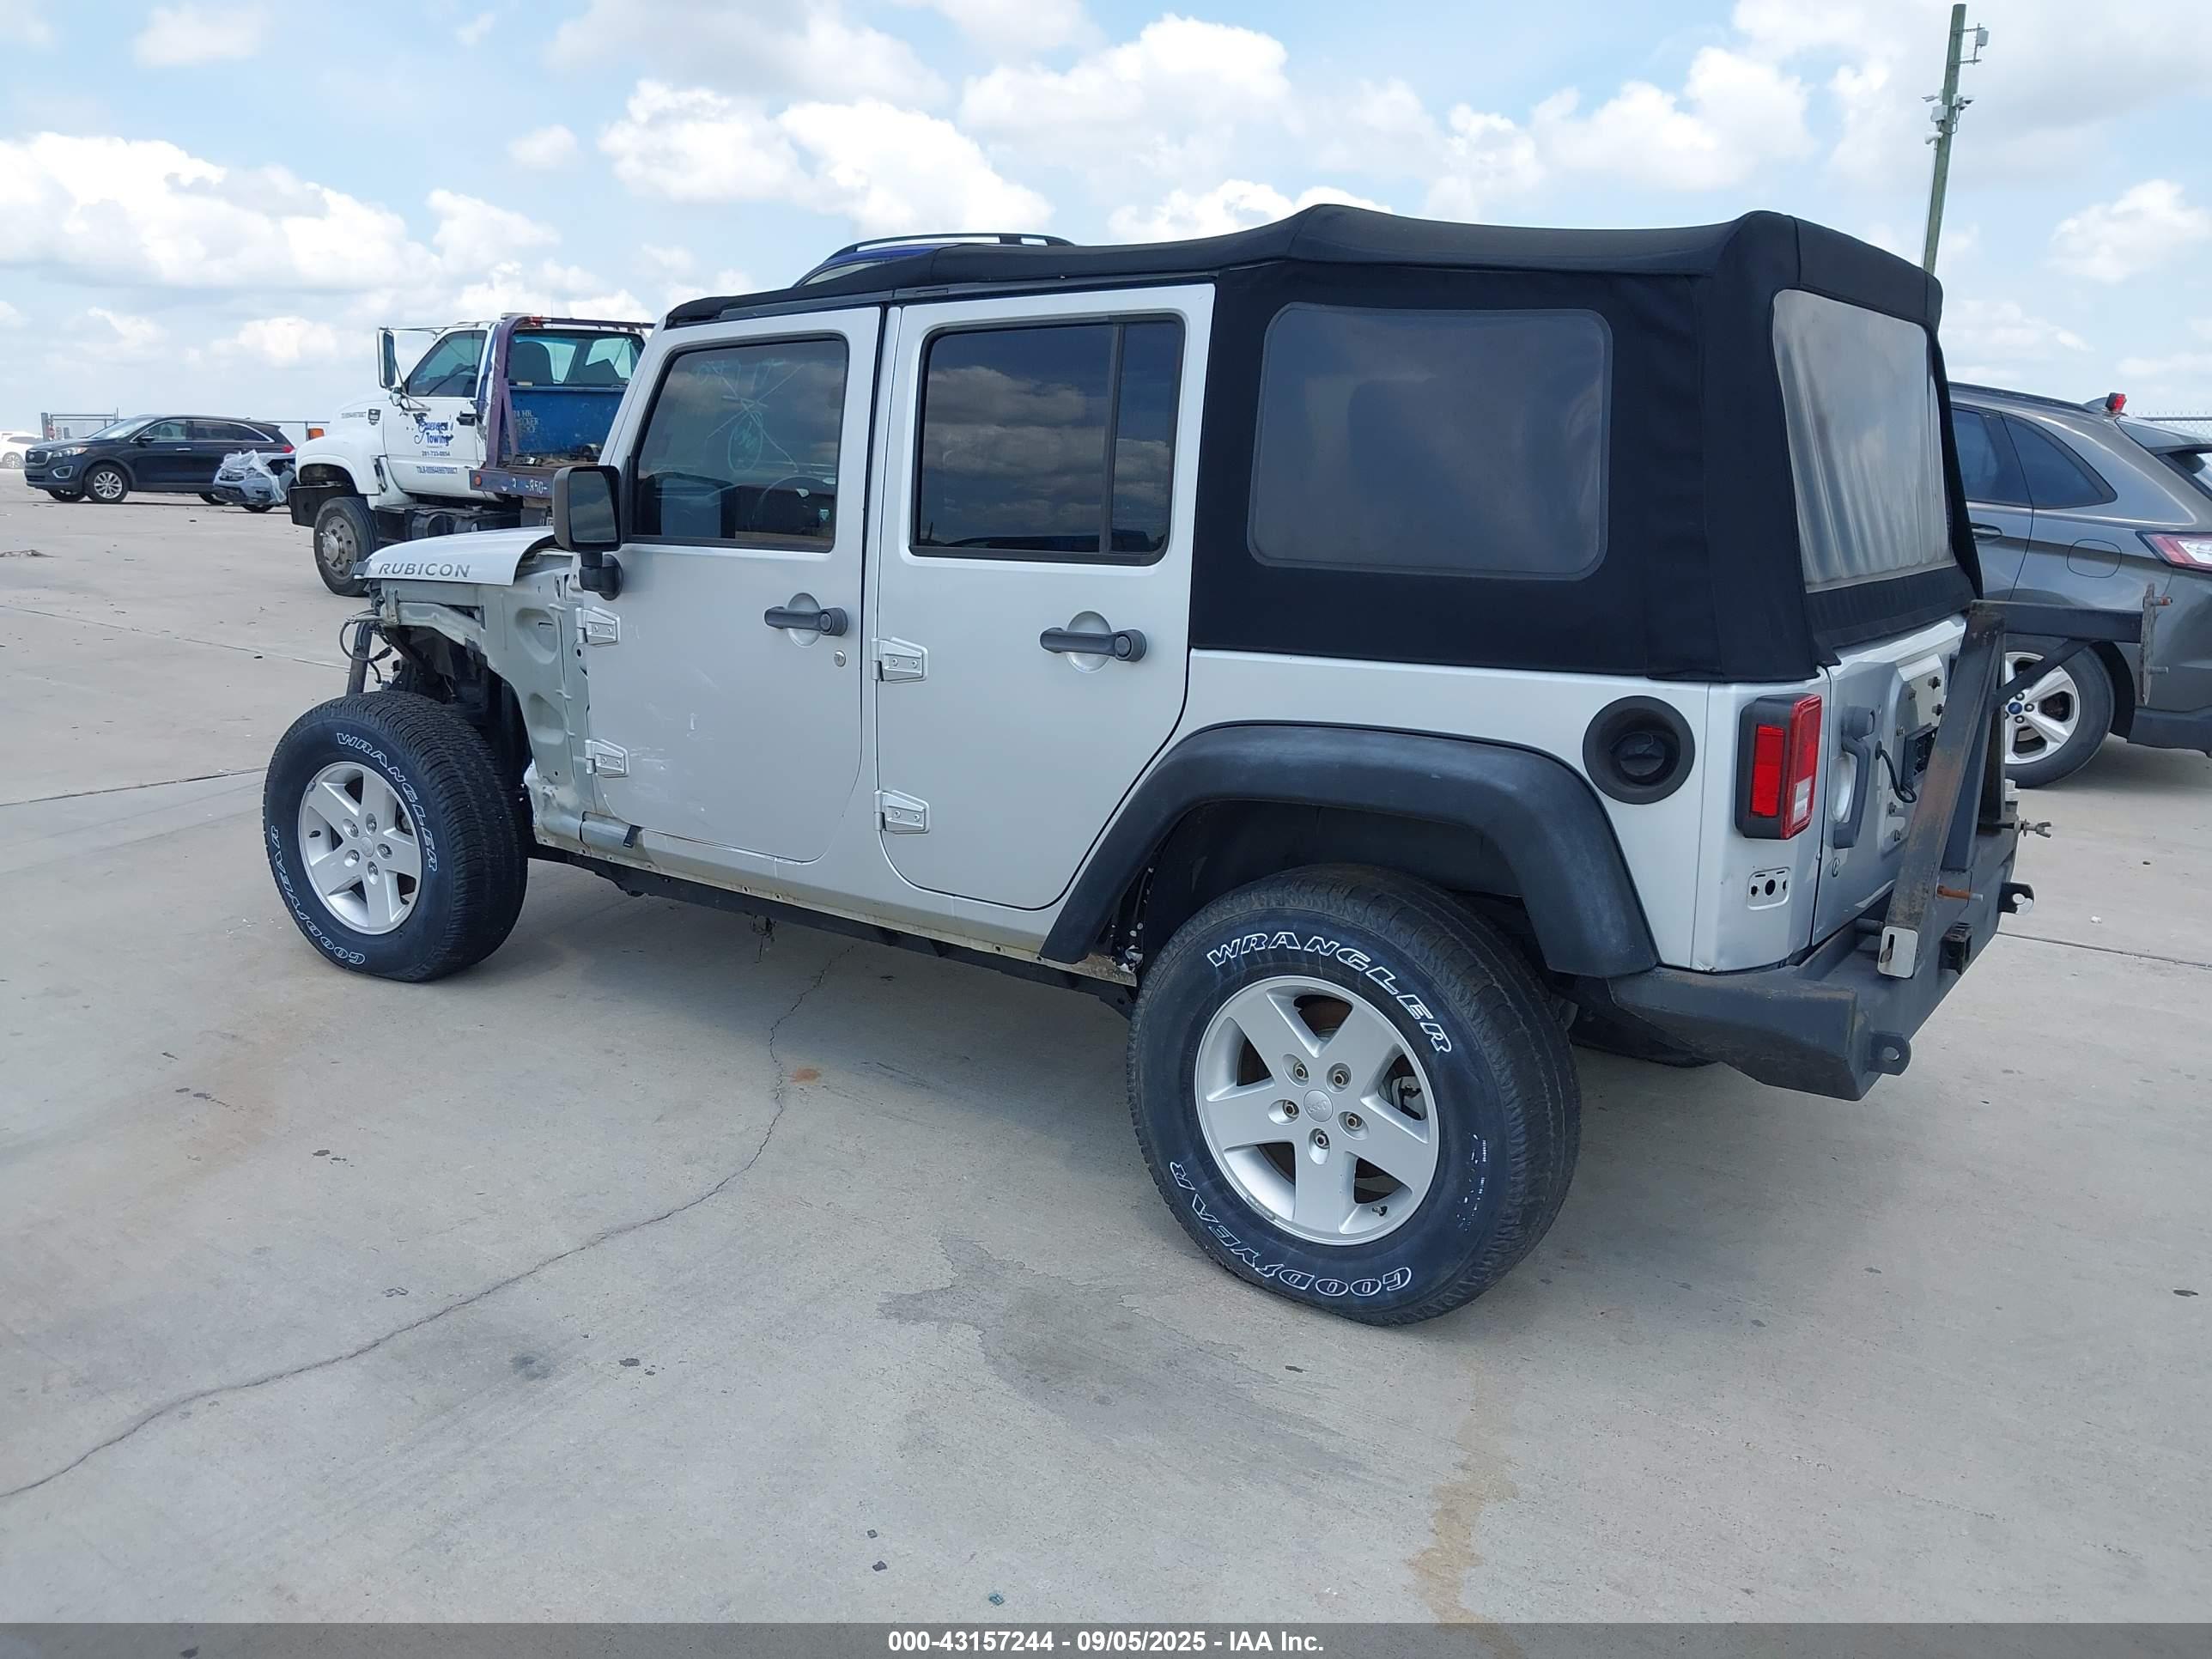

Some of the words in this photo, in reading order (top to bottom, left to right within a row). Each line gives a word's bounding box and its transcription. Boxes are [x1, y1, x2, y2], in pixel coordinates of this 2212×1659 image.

[426, 432, 453, 447] Towing
[378, 562, 471, 579] RUBICON
[336, 732, 439, 873] WRANGLER
[269, 824, 367, 966] GOODYEAR
[1206, 930, 1452, 1054] WRANGLER
[1168, 1160, 1413, 1297] GOODYEAR
